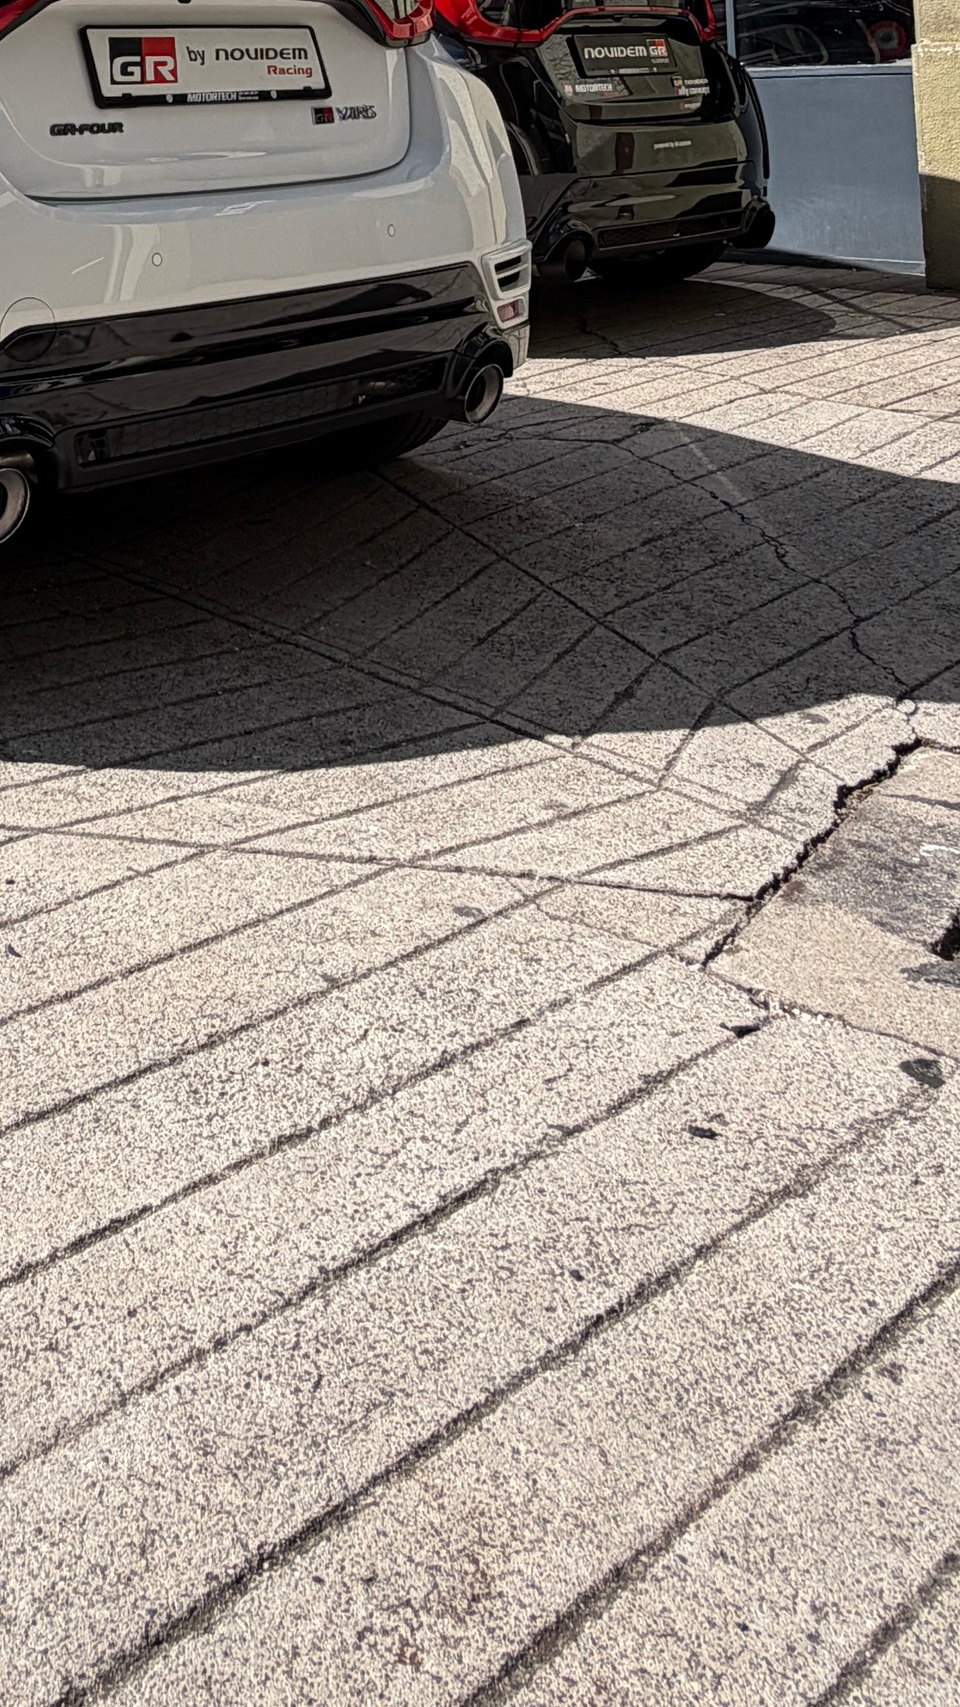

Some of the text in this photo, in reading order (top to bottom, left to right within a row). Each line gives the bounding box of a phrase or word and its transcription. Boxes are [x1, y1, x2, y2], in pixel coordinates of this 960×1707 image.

[648, 45, 668, 57] GR
[112, 55, 176, 82] GR
[186, 46, 205, 66] by
[266, 64, 314, 78] Racing
[186, 91, 238, 103] MOTORTECH
[335, 105, 377, 121] YARIS
[49, 122, 124, 136] GR-FOUR
